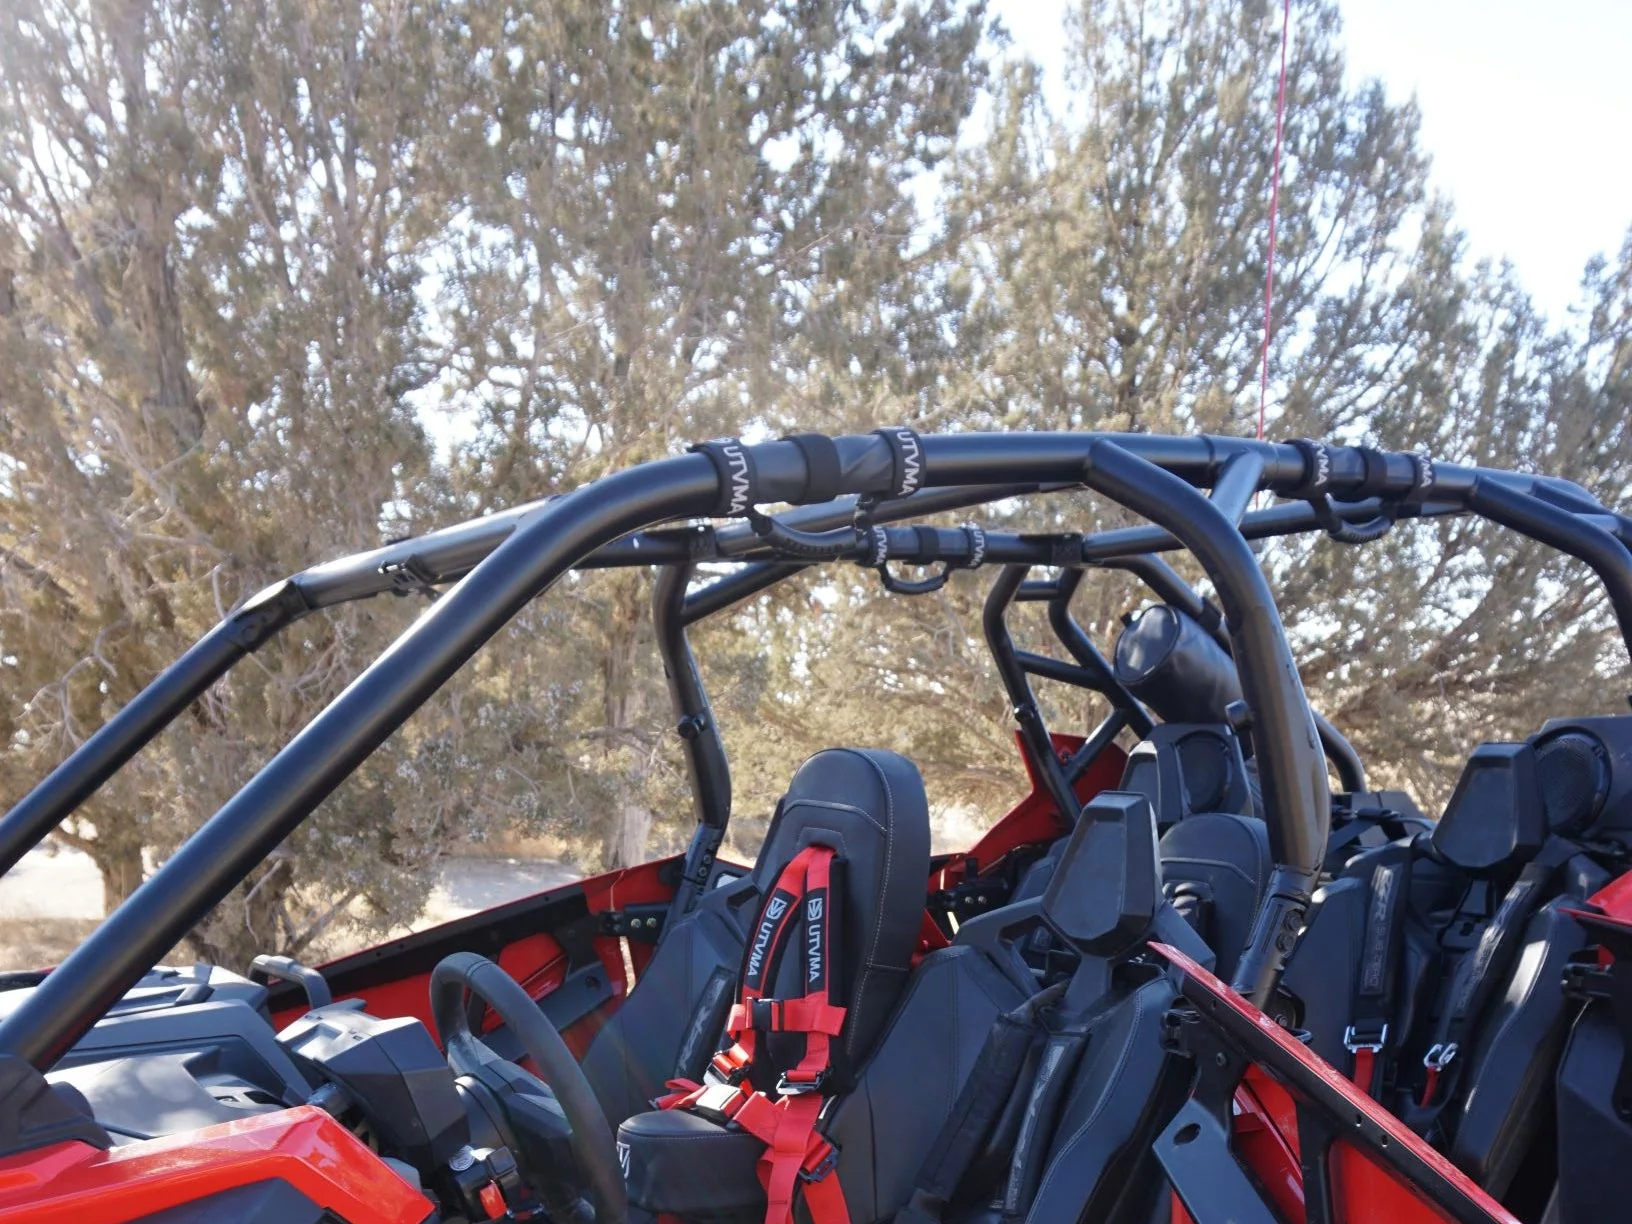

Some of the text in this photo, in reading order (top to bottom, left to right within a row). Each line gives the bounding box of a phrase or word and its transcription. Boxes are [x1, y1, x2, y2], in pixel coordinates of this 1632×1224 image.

[723, 446, 749, 515] UTVMA
[897, 431, 919, 496] UTVMA
[747, 921, 774, 976] UTVMA
[808, 924, 821, 983] UTVMA
